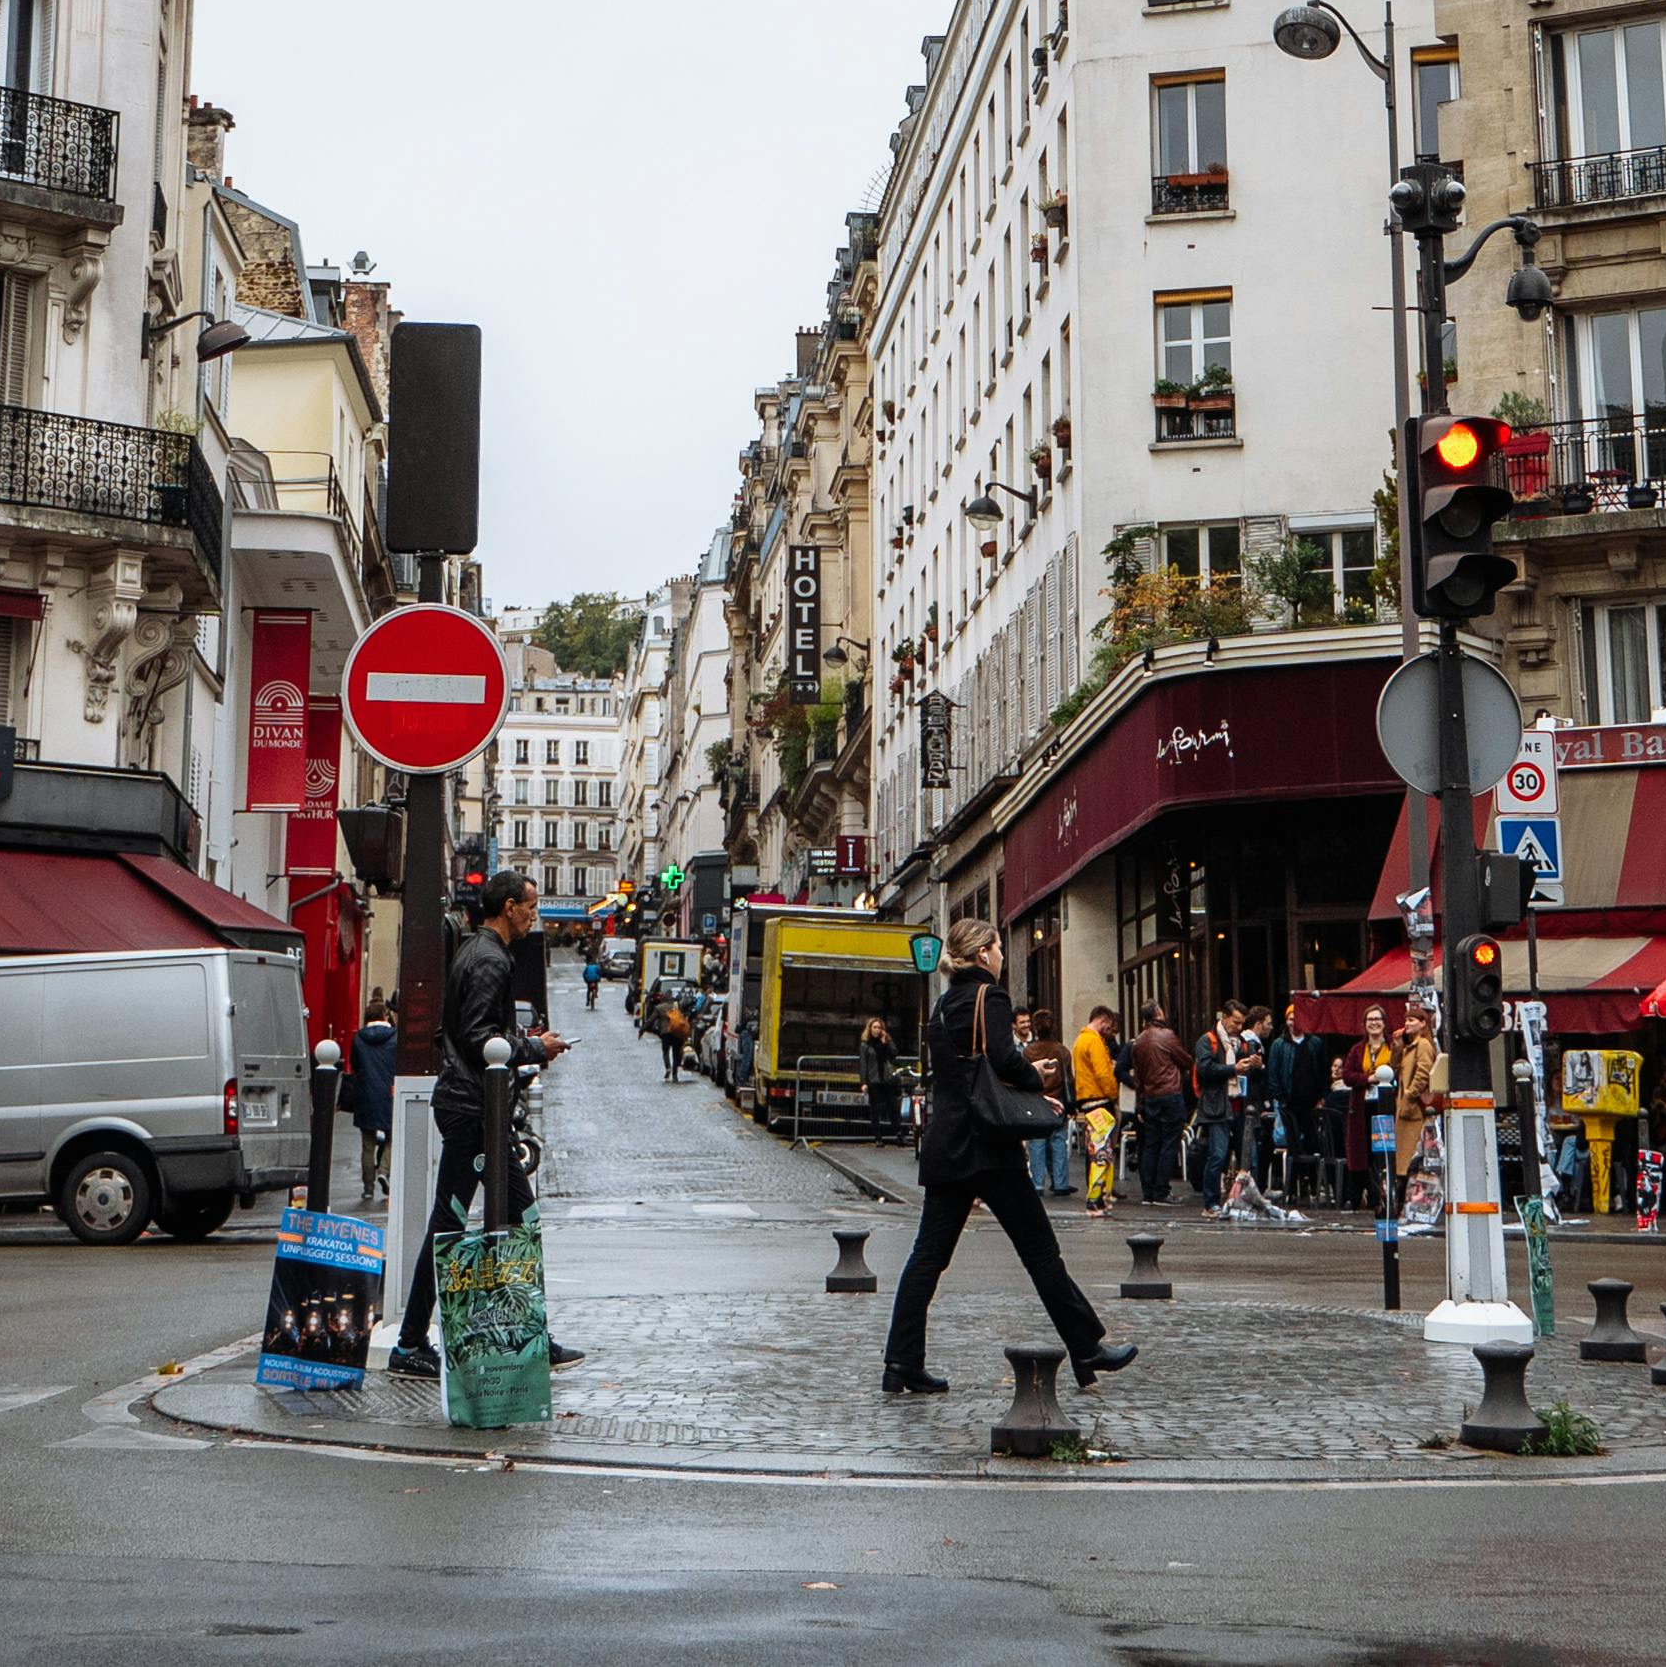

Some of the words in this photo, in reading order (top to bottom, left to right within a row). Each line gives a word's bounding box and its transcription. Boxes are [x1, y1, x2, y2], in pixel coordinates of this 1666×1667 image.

[794, 549, 817, 677] HOTEL
[253, 726, 304, 739] DIVAN
[253, 739, 268, 748] DU
[268, 739, 303, 749] MONDE
[1556, 733, 1605, 765] yal
[1514, 773, 1538, 790] 30
[305, 800, 333, 809] DAME
[287, 1213, 314, 1233] THE
[317, 1218, 380, 1247] HYENES
[306, 1236, 354, 1253] KRAKATOA
[282, 1243, 334, 1261] UNPLUGGED
[334, 1251, 379, 1269] SESSIONS
[264, 1357, 293, 1370] NOUVEL
